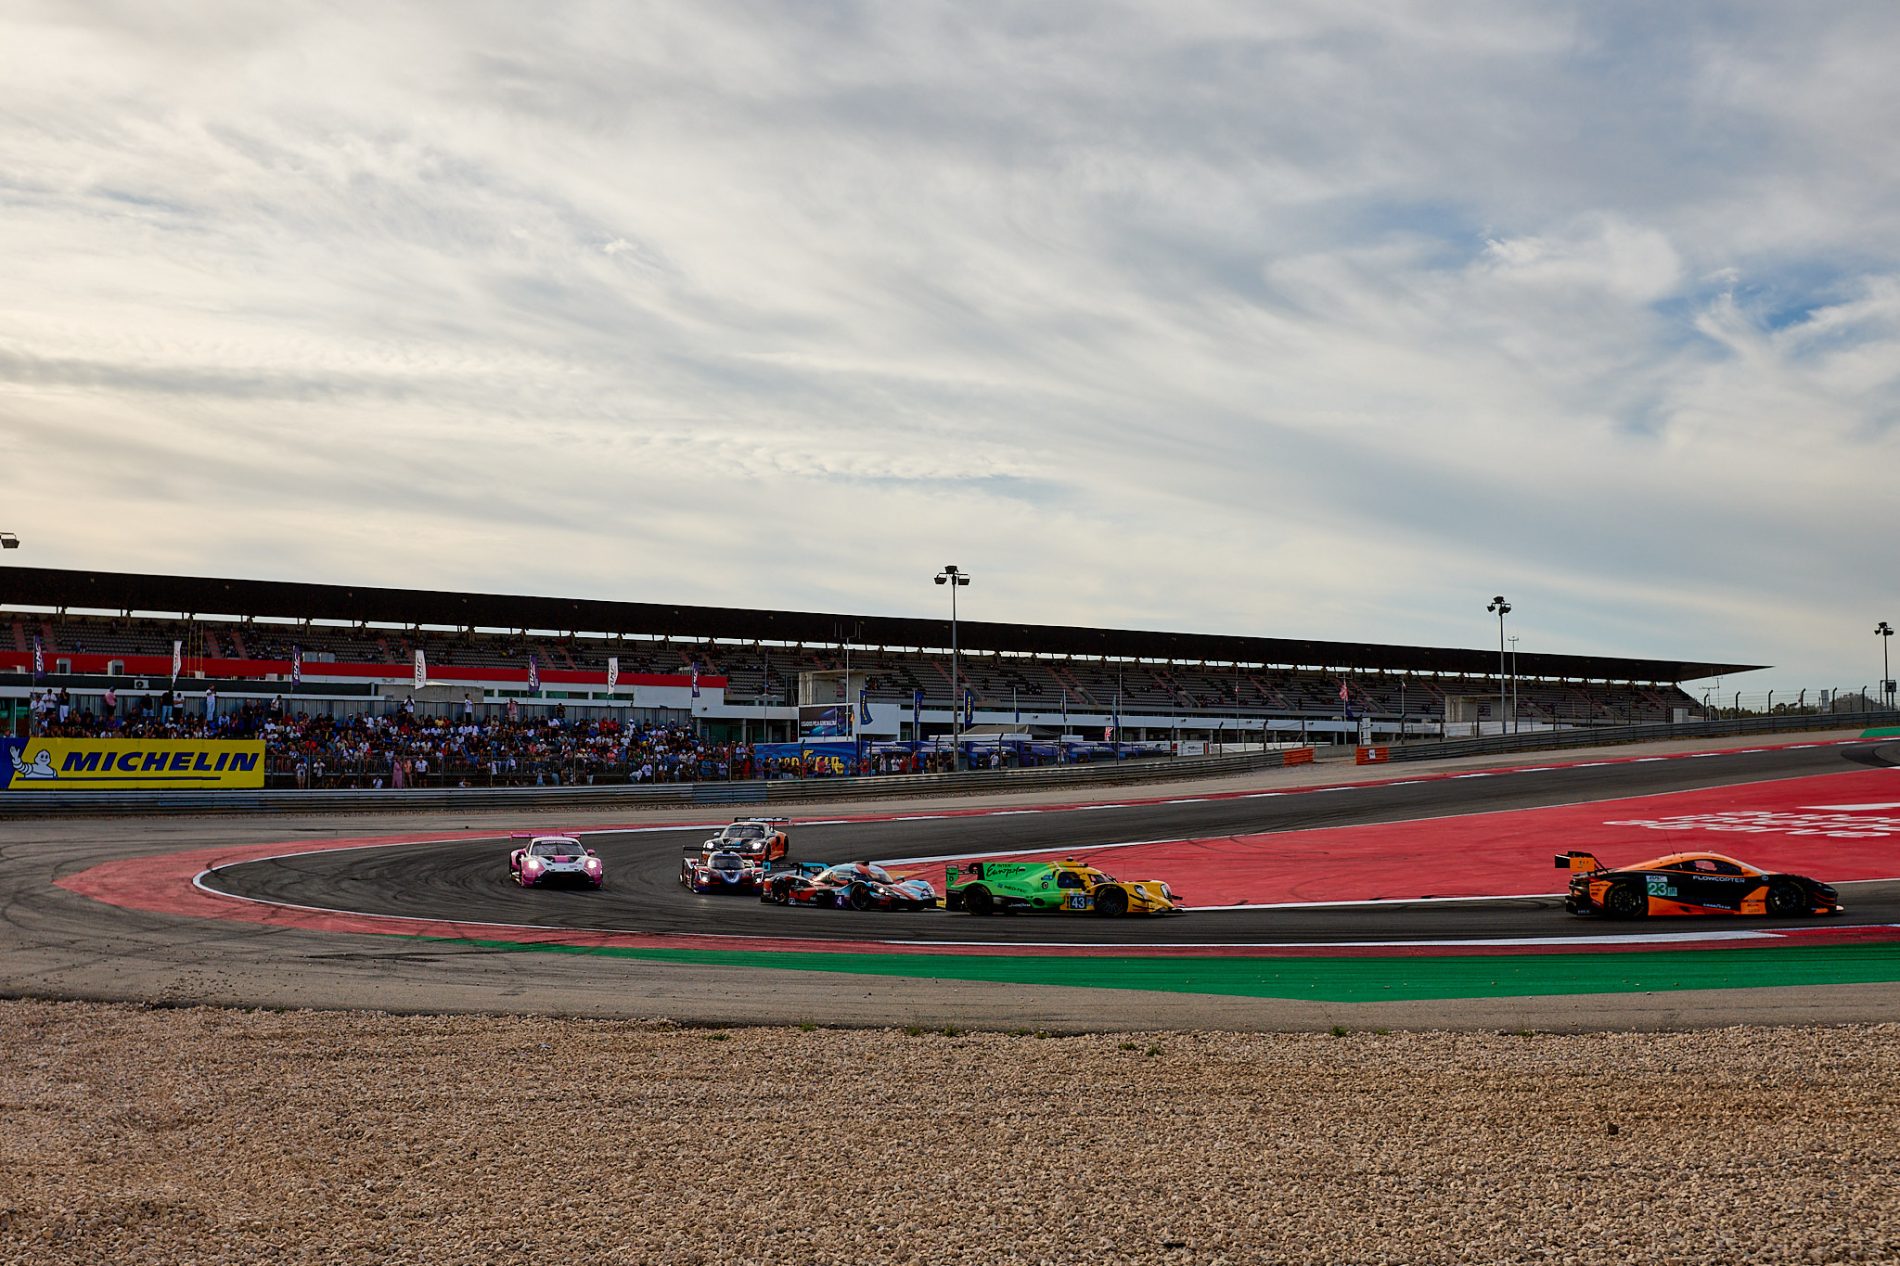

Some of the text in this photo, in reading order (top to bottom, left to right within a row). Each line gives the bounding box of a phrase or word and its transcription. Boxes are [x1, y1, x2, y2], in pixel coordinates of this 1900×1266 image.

[61, 751, 260, 772] MICHELIN
[1692, 875, 1746, 883] FLOWCOPTER
[1648, 882, 1667, 896] 23
[836, 896, 843, 906] 4
[1071, 897, 1085, 909] 43
